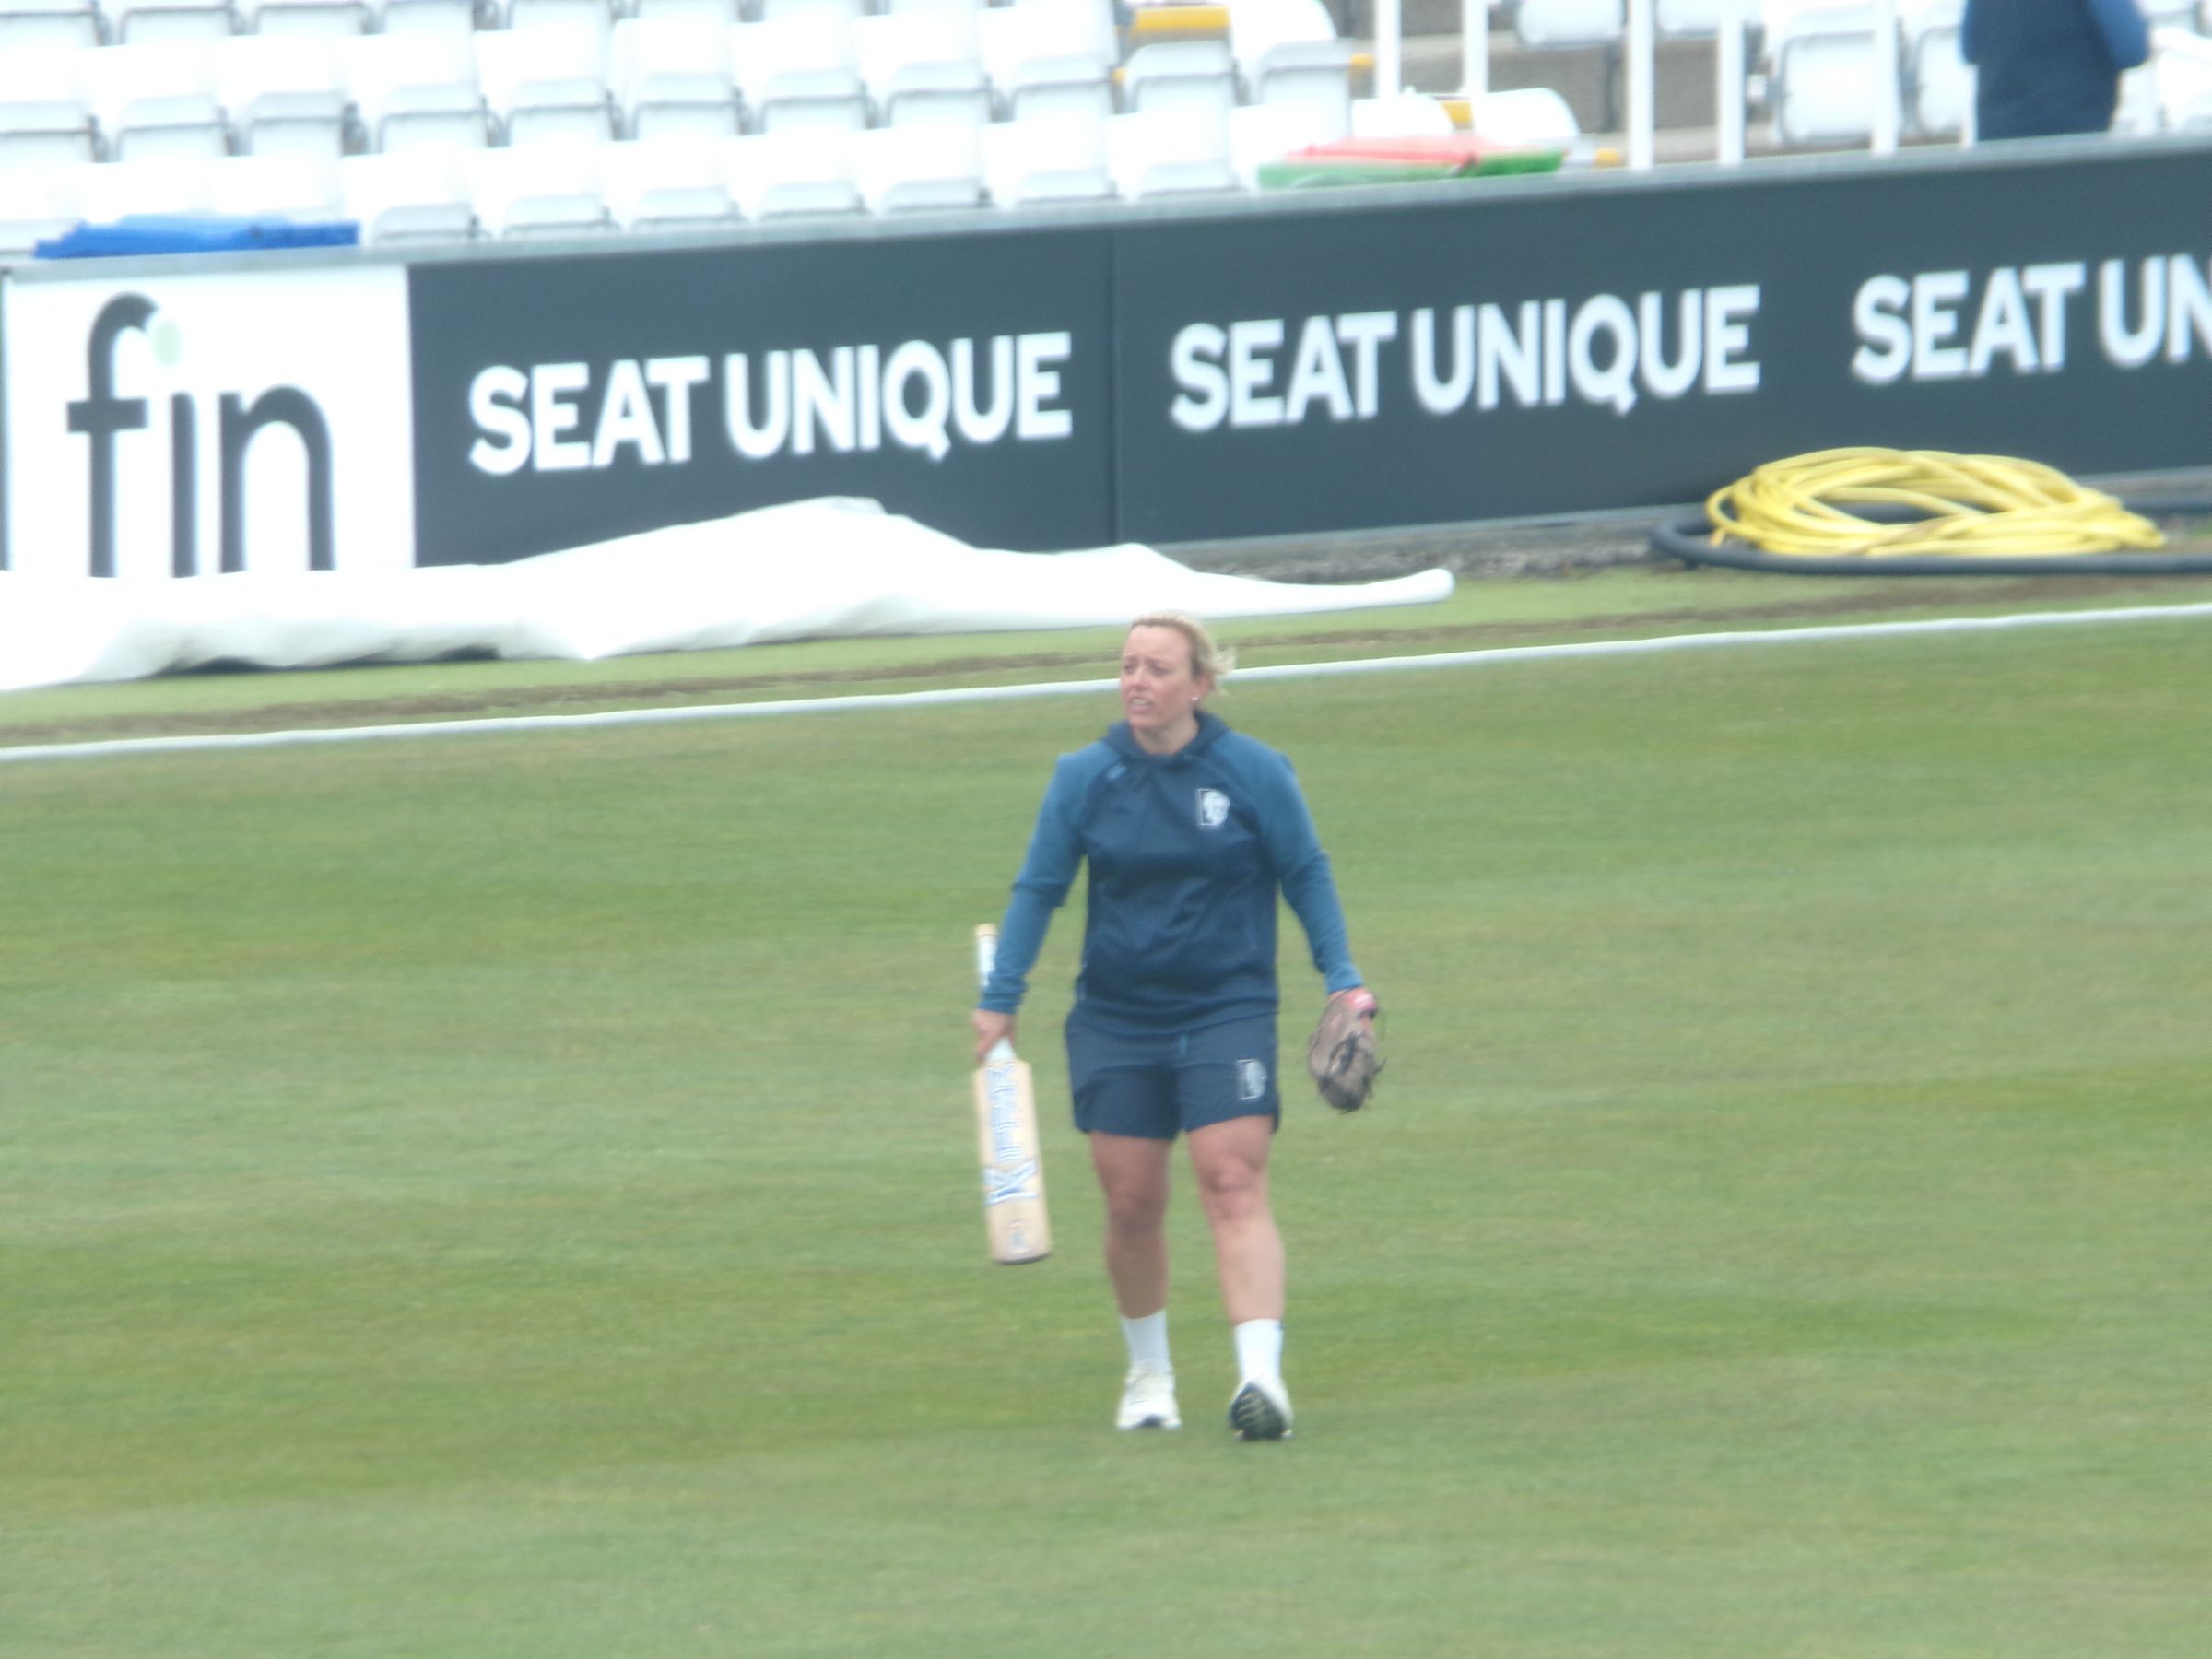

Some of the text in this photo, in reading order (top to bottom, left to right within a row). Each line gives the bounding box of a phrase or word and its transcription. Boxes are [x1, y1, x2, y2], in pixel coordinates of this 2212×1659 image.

[1170, 284, 1760, 431] SEAT UNIQUE
[1852, 262, 2085, 384] SEAT
[65, 292, 335, 578] fin
[467, 330, 1073, 476] SEAT UNIQUE
